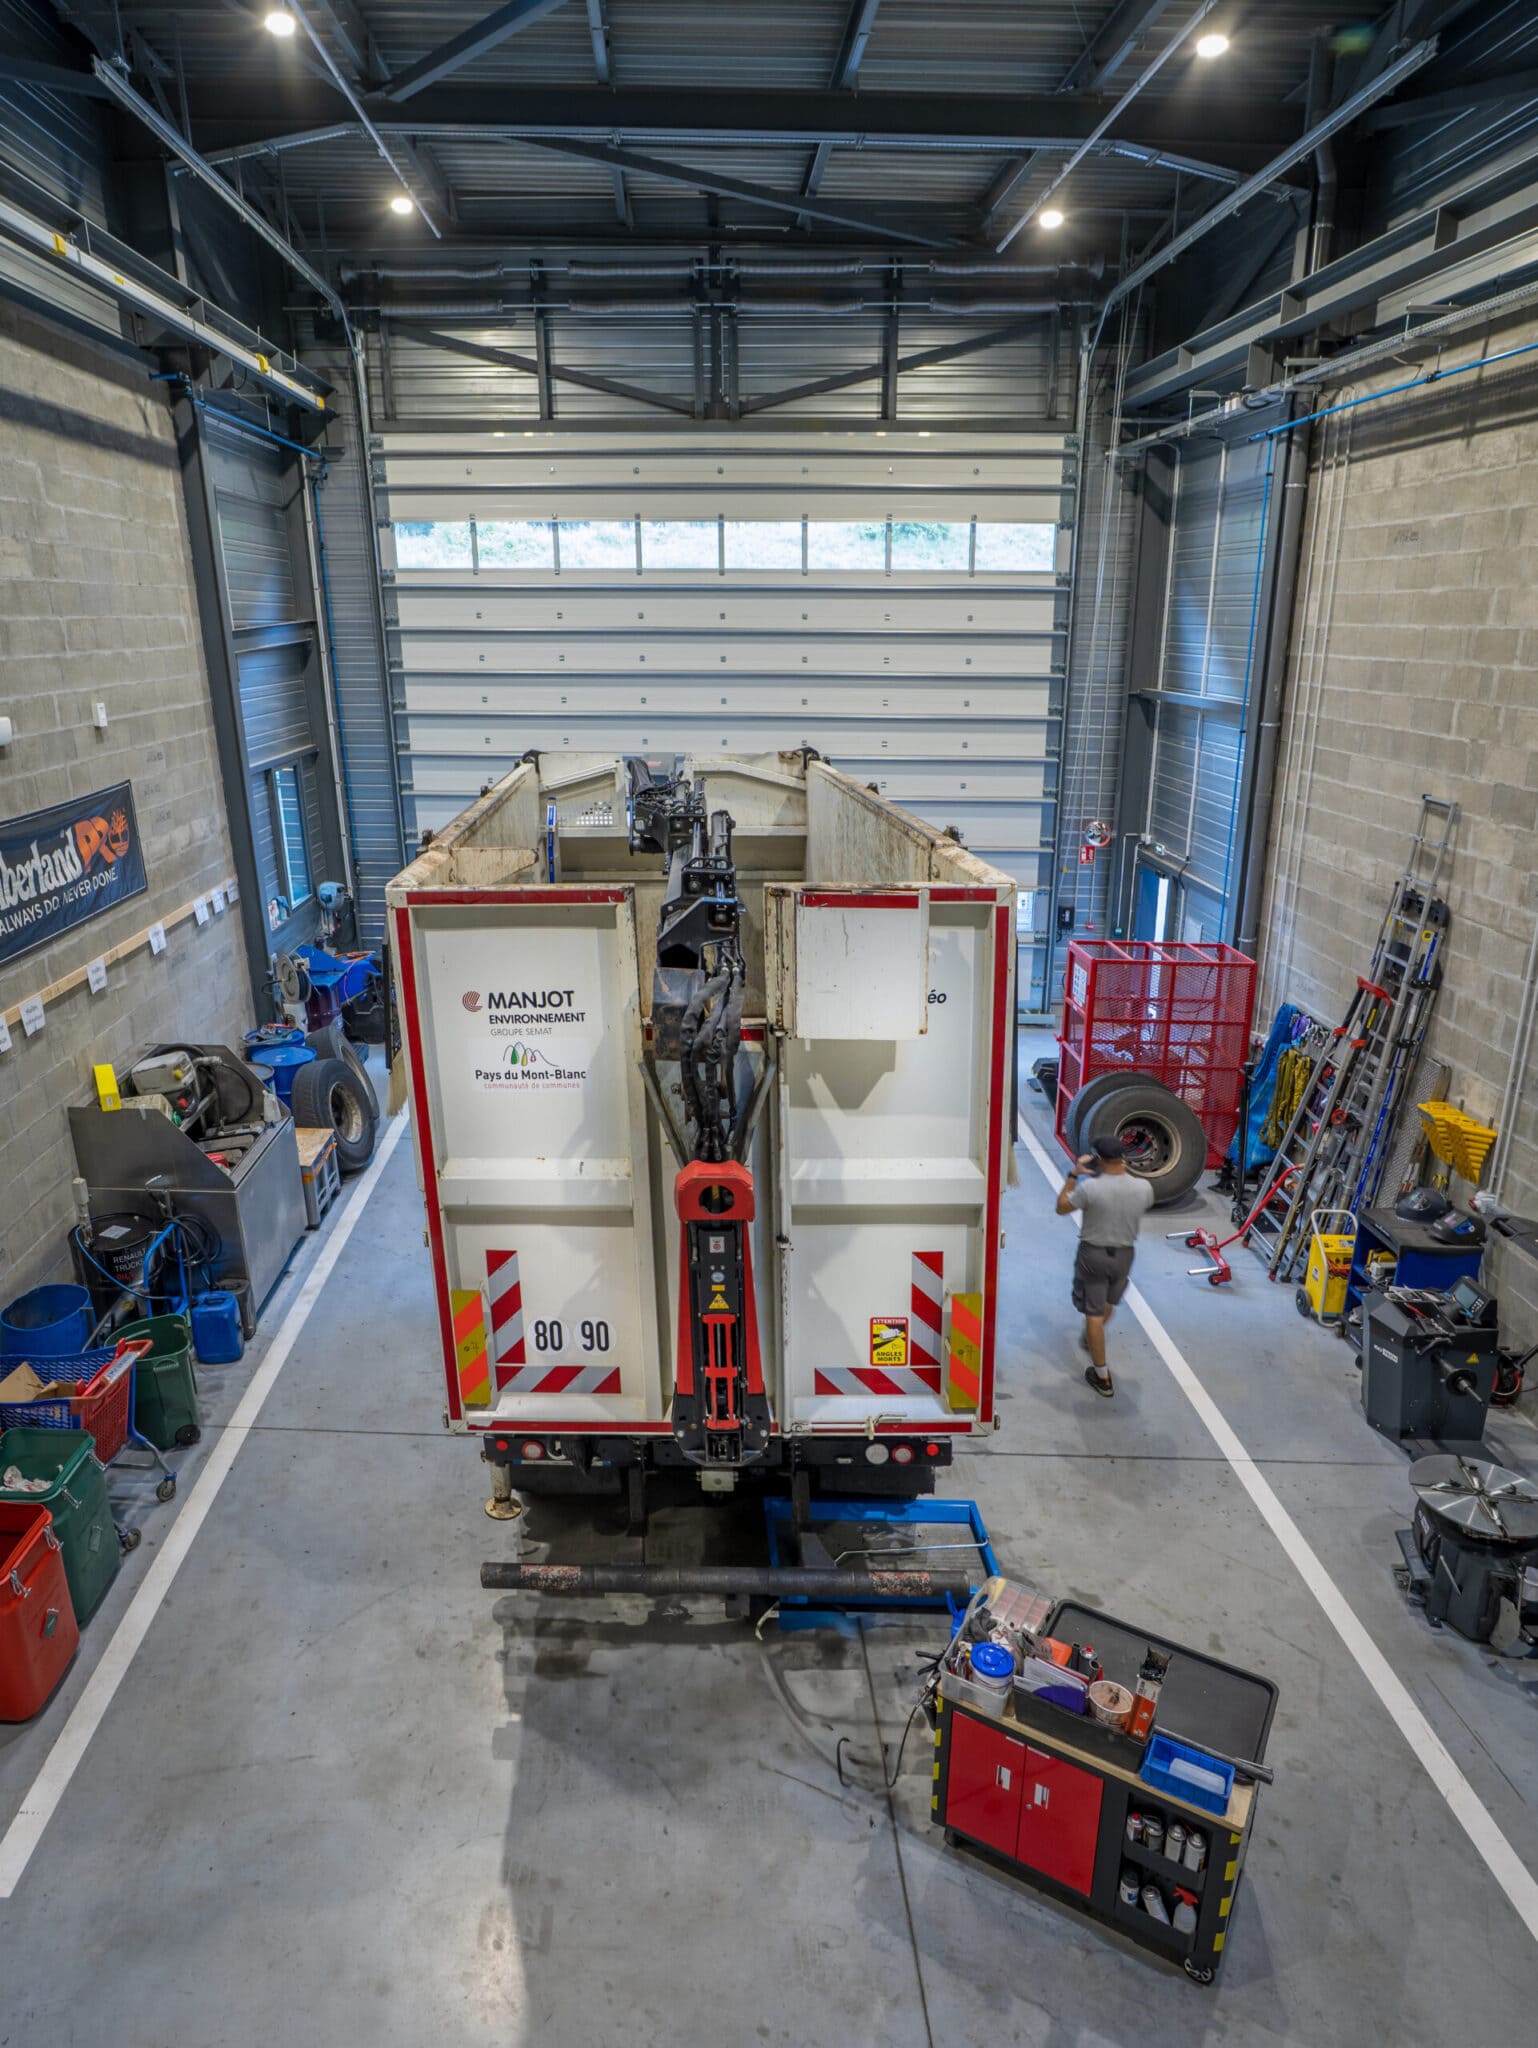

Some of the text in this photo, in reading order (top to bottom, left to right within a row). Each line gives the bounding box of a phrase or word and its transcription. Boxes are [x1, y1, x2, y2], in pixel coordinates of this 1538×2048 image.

[0, 827, 83, 911] berland
[0, 903, 43, 936] ALWAYS
[62, 879, 91, 905] NEVER
[488, 990, 575, 1009] MANJOT
[489, 1012, 586, 1024] ENVIRONNEMENT
[490, 1027, 553, 1037] GROUPE SEMAT
[475, 1069, 587, 1082] Pays du Mont-Blanc
[531, 1081, 540, 1089] de
[542, 1081, 580, 1089] communes
[535, 1320, 609, 1351] 80 90
